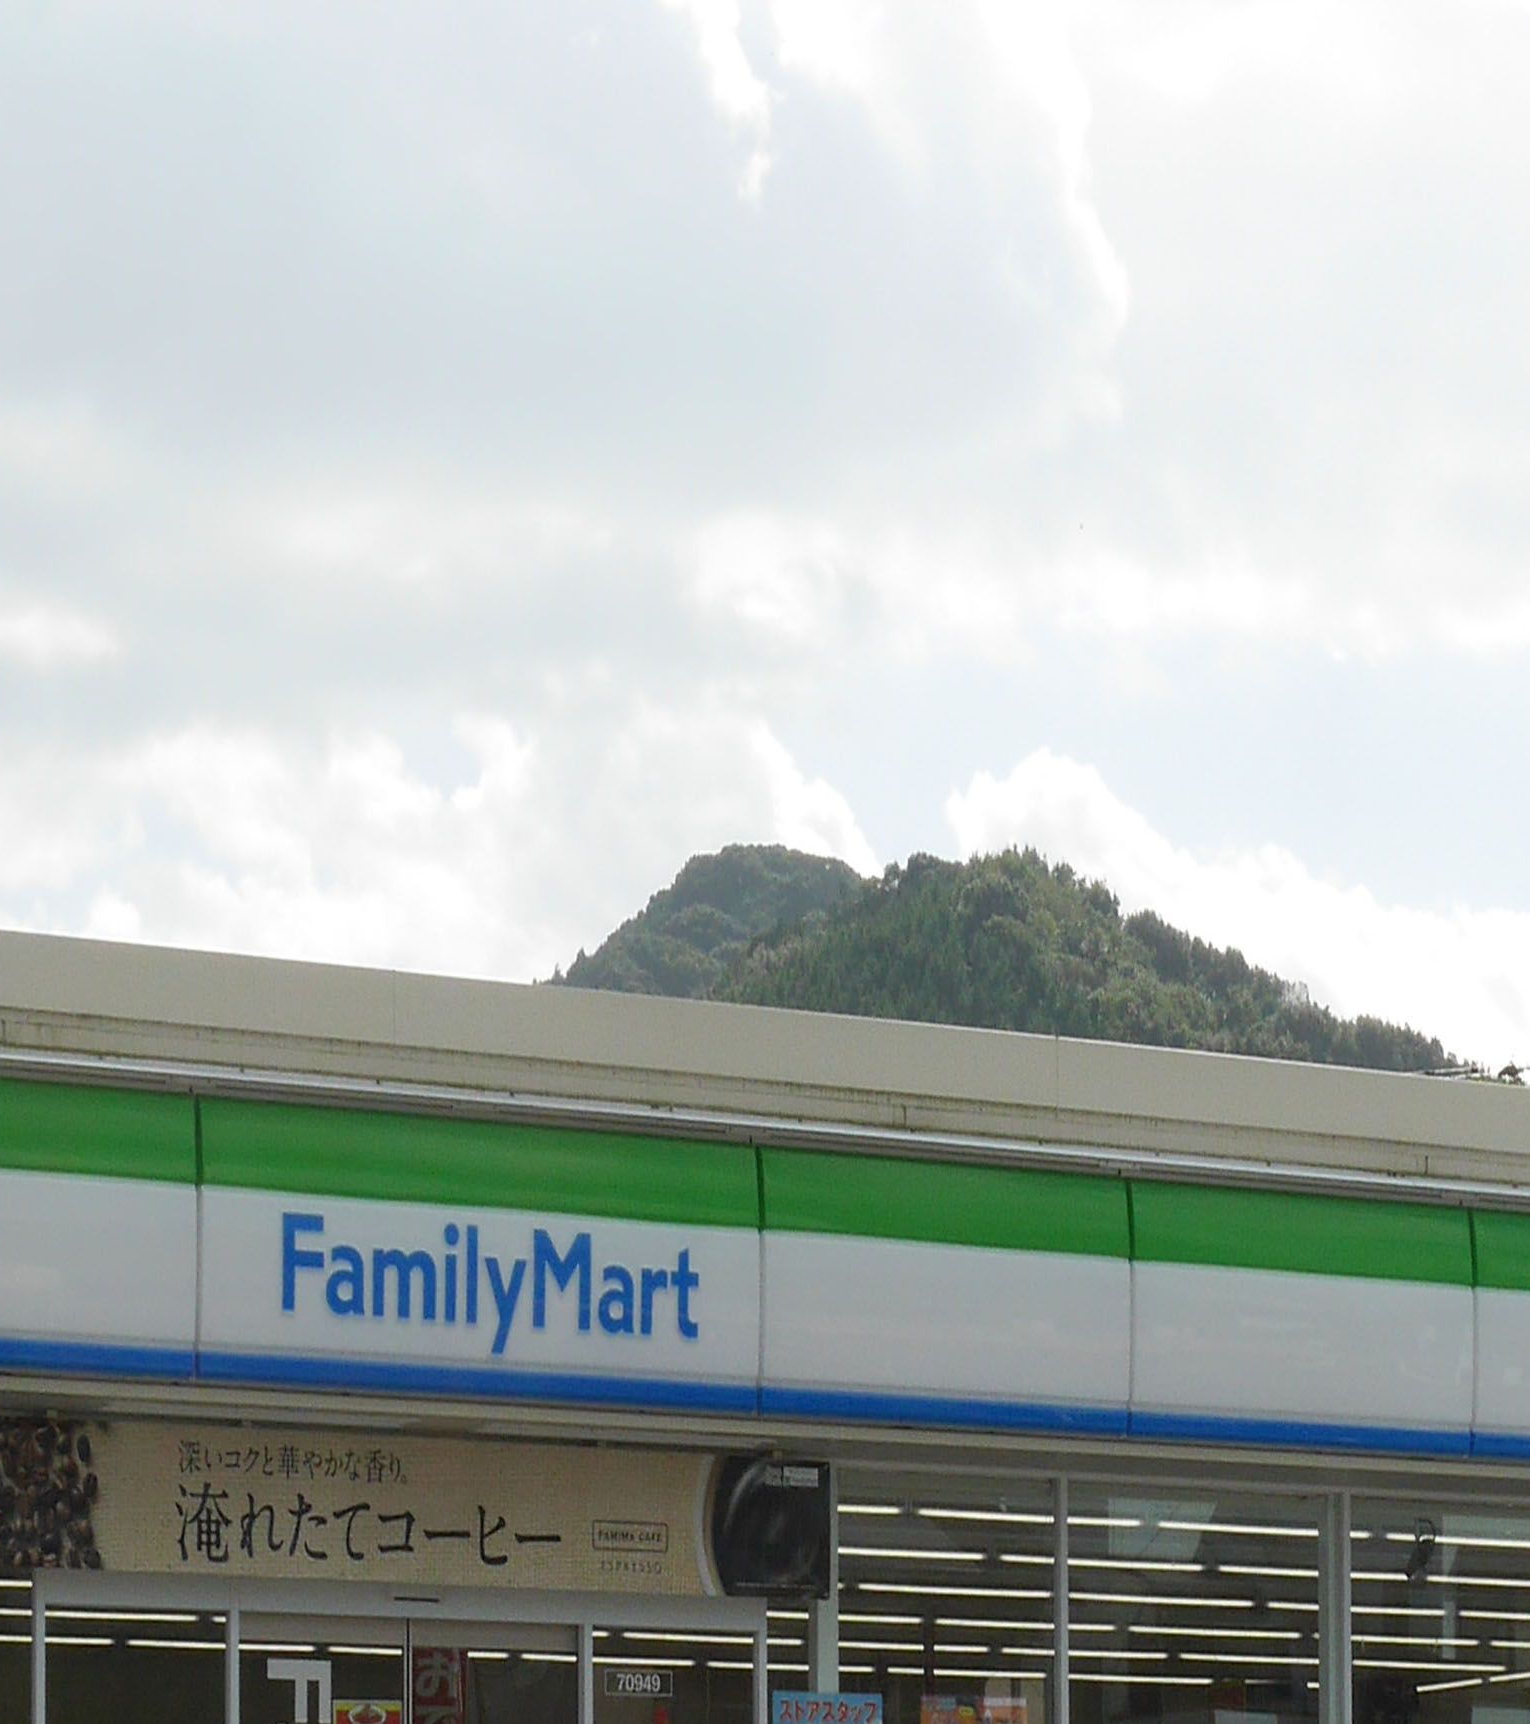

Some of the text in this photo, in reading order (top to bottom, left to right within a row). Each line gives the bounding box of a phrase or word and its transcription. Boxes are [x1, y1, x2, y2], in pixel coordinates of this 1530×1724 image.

[282, 1211, 699, 1355] FamilyMart
[178, 1439, 409, 1485] 深いコクと華やかな香り。
[174, 1482, 562, 1567] 淹れたてコーヒー
[616, 1674, 662, 1692] 70949
